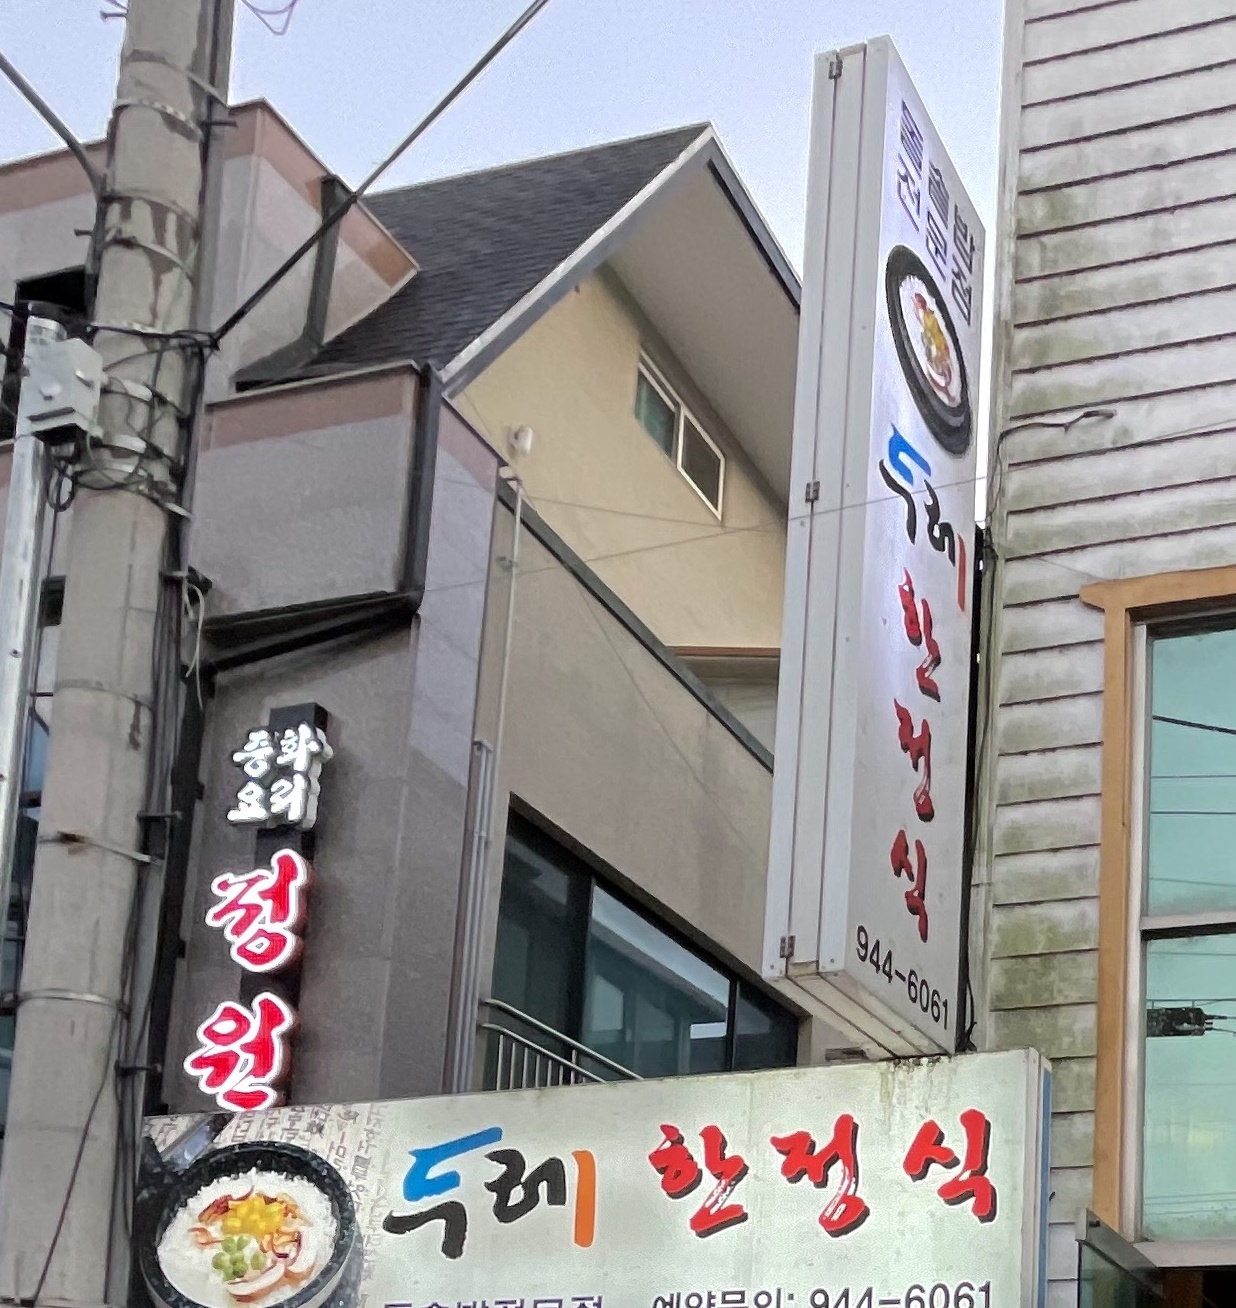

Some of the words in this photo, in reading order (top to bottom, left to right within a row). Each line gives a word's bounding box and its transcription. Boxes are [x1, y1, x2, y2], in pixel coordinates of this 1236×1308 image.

[896, 152, 973, 328] 전문점
[899, 99, 976, 277] 돌솥밥
[879, 423, 967, 613] 두레
[227, 773, 310, 824] 요리
[232, 722, 322, 777] 중화
[890, 567, 942, 943] 한정식
[856, 925, 948, 1031] 944-6061
[382, 1124, 595, 1260] 두레
[647, 1108, 999, 1239] 한정식
